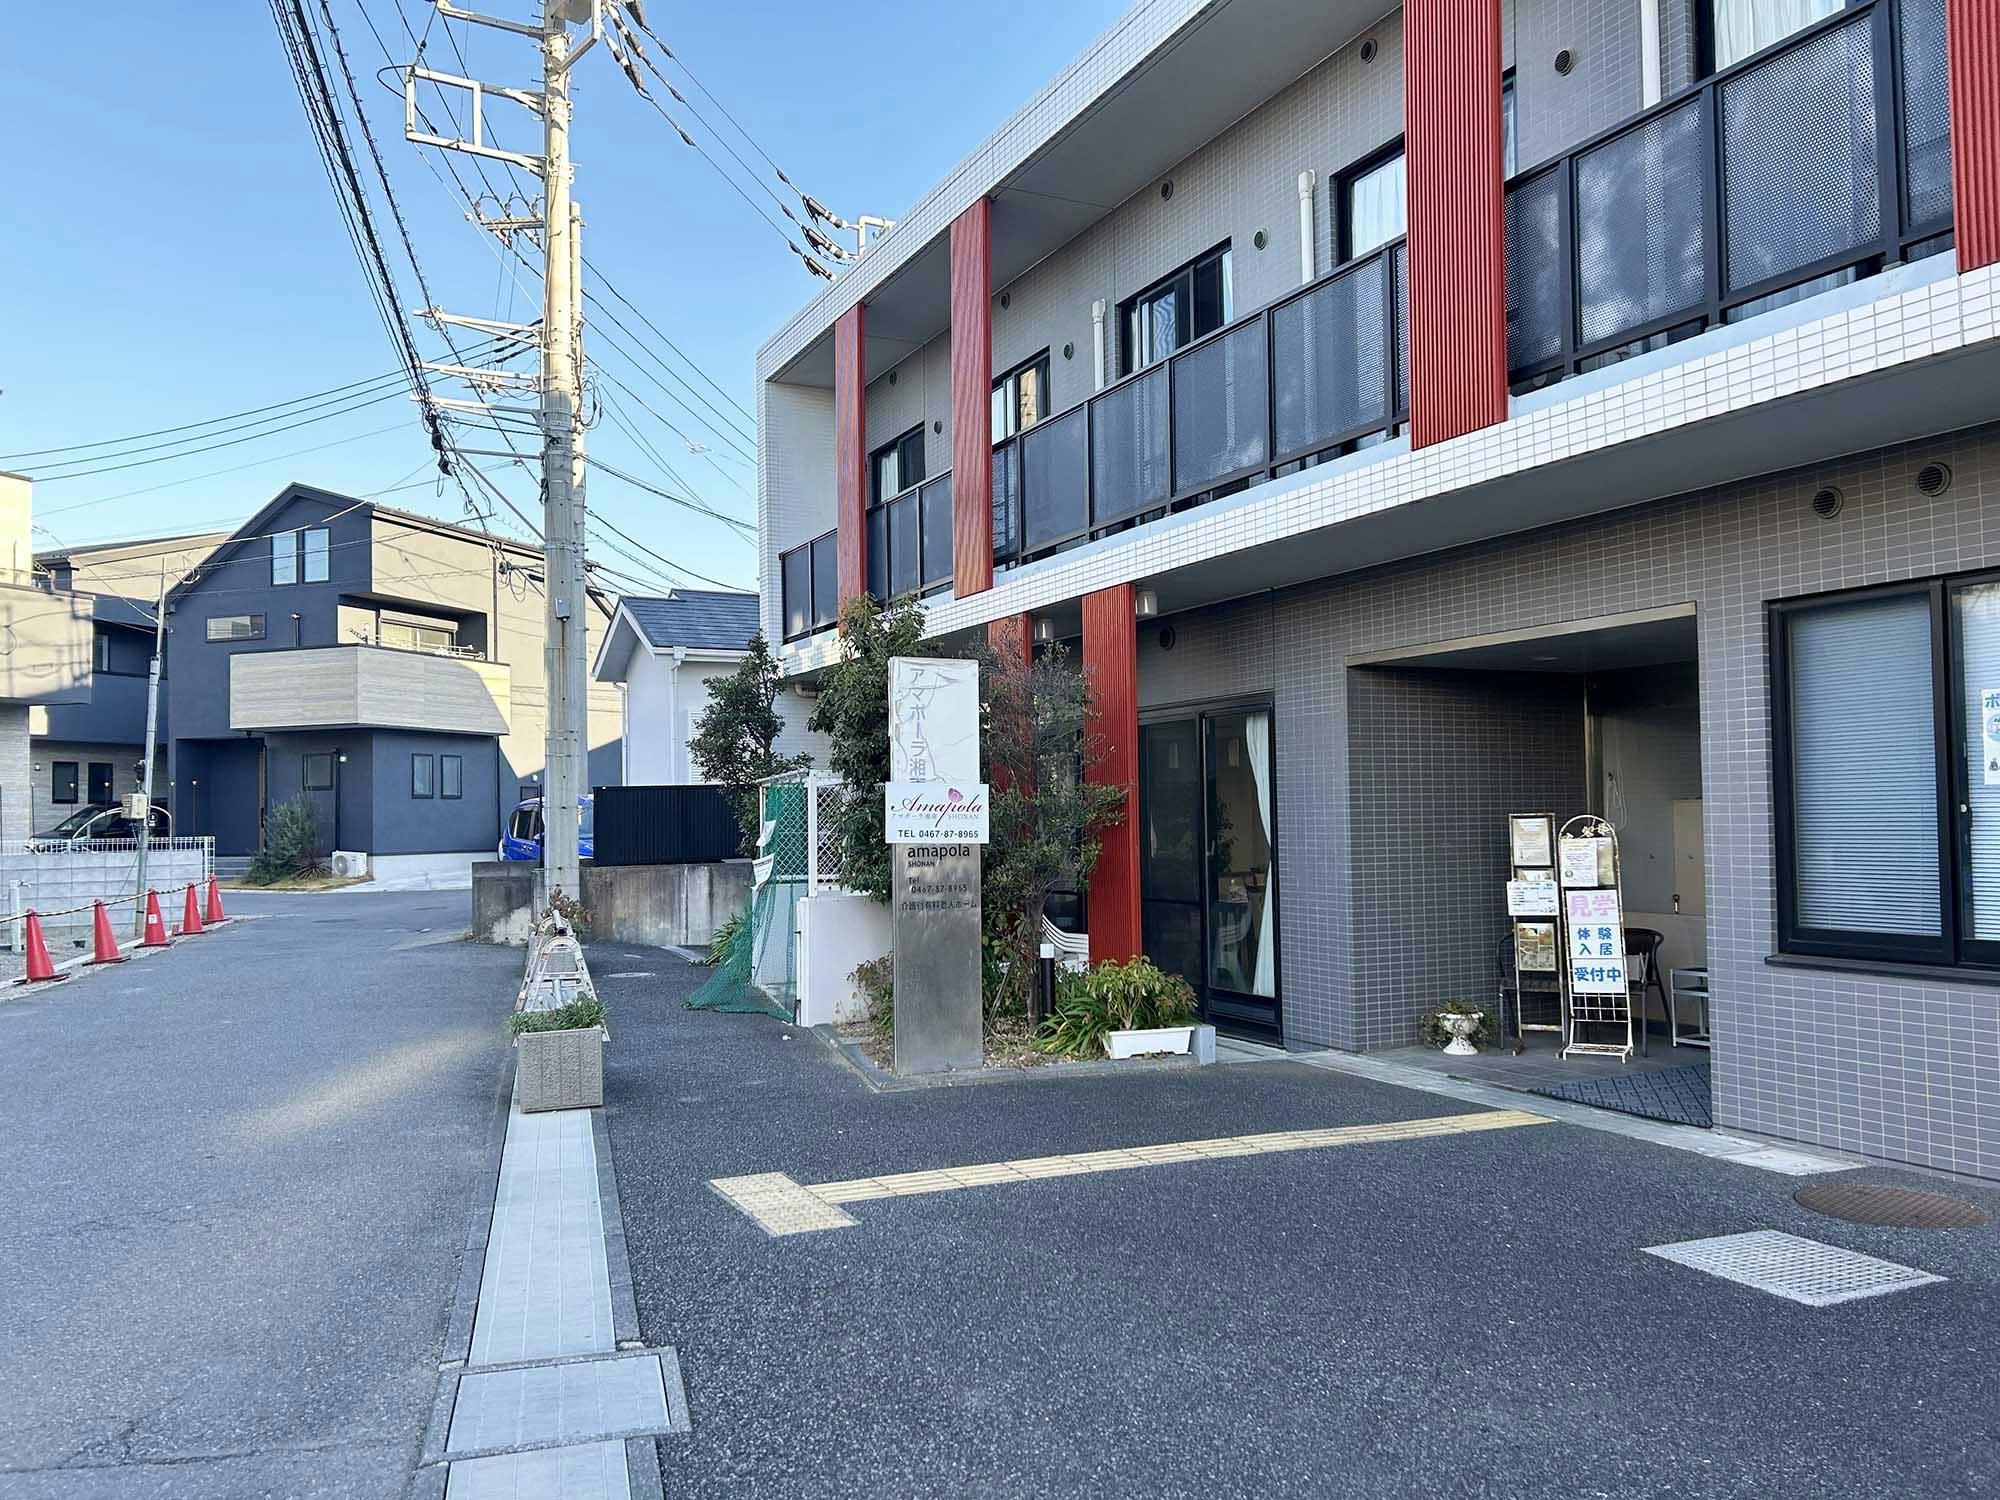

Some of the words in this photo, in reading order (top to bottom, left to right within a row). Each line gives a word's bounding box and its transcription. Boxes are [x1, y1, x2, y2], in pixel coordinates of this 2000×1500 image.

[891, 793, 983, 828] Amapola
[898, 829, 916, 838] TEL
[918, 829, 979, 838] 0467-87-8965
[907, 844, 970, 860] amapola
[907, 860, 935, 868] SHONAN
[908, 877, 920, 885] Tel
[1570, 895, 1617, 917] 見学
[1577, 927, 1612, 940] 体験
[1579, 943, 1613, 956] 入居
[1574, 967, 1622, 982] 受付中
